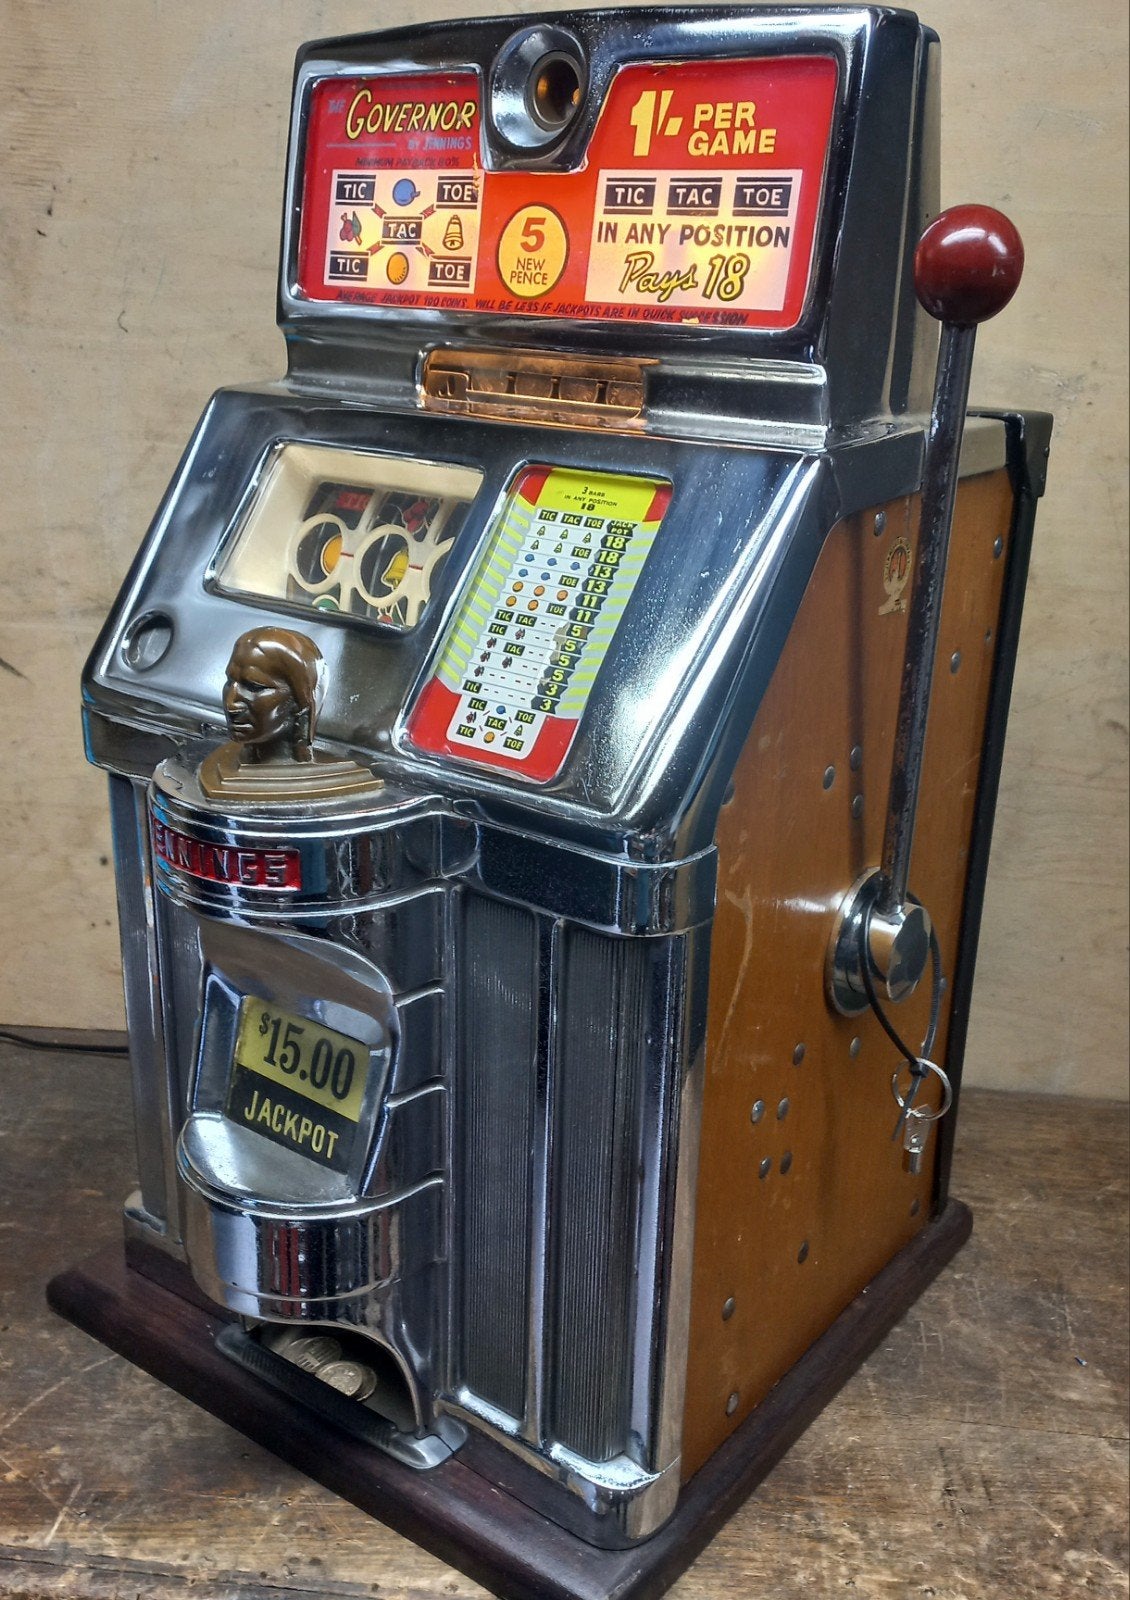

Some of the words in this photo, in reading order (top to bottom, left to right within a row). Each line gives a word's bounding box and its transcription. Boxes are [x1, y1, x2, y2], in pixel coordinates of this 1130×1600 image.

[346, 88, 477, 140] GOVERNOR
[693, 101, 756, 130] PER
[423, 135, 472, 151] JENNINGS
[688, 128, 777, 157] GAME
[343, 183, 367, 199] TIC
[442, 184, 473, 201] TOE
[615, 187, 646, 204] TIC
[676, 188, 713, 205] TAC
[743, 188, 784, 206] TOE
[388, 223, 416, 238] TAC
[520, 217, 546, 252] 5
[597, 221, 618, 243] IN
[625, 223, 671, 245] ANY
[679, 224, 790, 248] POSITION
[337, 258, 361, 273] TIC
[435, 264, 464, 280] TOE
[516, 257, 546, 271] NEW
[509, 271, 548, 285] PENCE
[618, 250, 698, 303] Pays
[702, 252, 750, 301] 18
[475, 299, 495, 309] WILL
[499, 301, 511, 311] BE
[515, 302, 539, 311] LESS
[541, 302, 551, 313] IF
[553, 303, 600, 316] JACKPOTS
[603, 306, 624, 318] ARE
[627, 307, 639, 318] IN
[643, 308, 674, 320] QUICK
[581, 486, 588, 495] 3
[580, 502, 595, 511] 18
[589, 498, 617, 507] POSITION
[541, 511, 555, 520] TIC
[563, 514, 580, 524] TAC
[587, 518, 603, 528] TOE
[611, 520, 634, 528] JACK
[611, 527, 629, 535] POT
[606, 535, 625, 549] 18
[574, 547, 590, 558] TOE
[599, 550, 618, 563] 18
[593, 564, 611, 578] 13
[562, 576, 577, 586] TOE
[586, 580, 606, 593] 13
[582, 594, 598, 607] 11
[549, 605, 564, 614] TOE
[576, 610, 591, 622] 11
[498, 610, 511, 620] TIC
[518, 615, 534, 625] TAC
[571, 625, 583, 637] 5
[491, 625, 504, 634] TIC
[564, 639, 577, 651] 5
[506, 644, 522, 654] TAC
[558, 654, 570, 667] 5
[553, 669, 565, 682] 5
[465, 682, 478, 692] TIC
[539, 698, 552, 711] 3
[545, 683, 558, 696] 3
[470, 700, 484, 709] TIC
[517, 712, 533, 722] TOE
[487, 717, 504, 729] TAC
[459, 727, 473, 736] TIC
[506, 738, 522, 749] TOE
[258, 1012, 355, 1100] $15.00
[244, 1090, 339, 1159] JACKPOT
